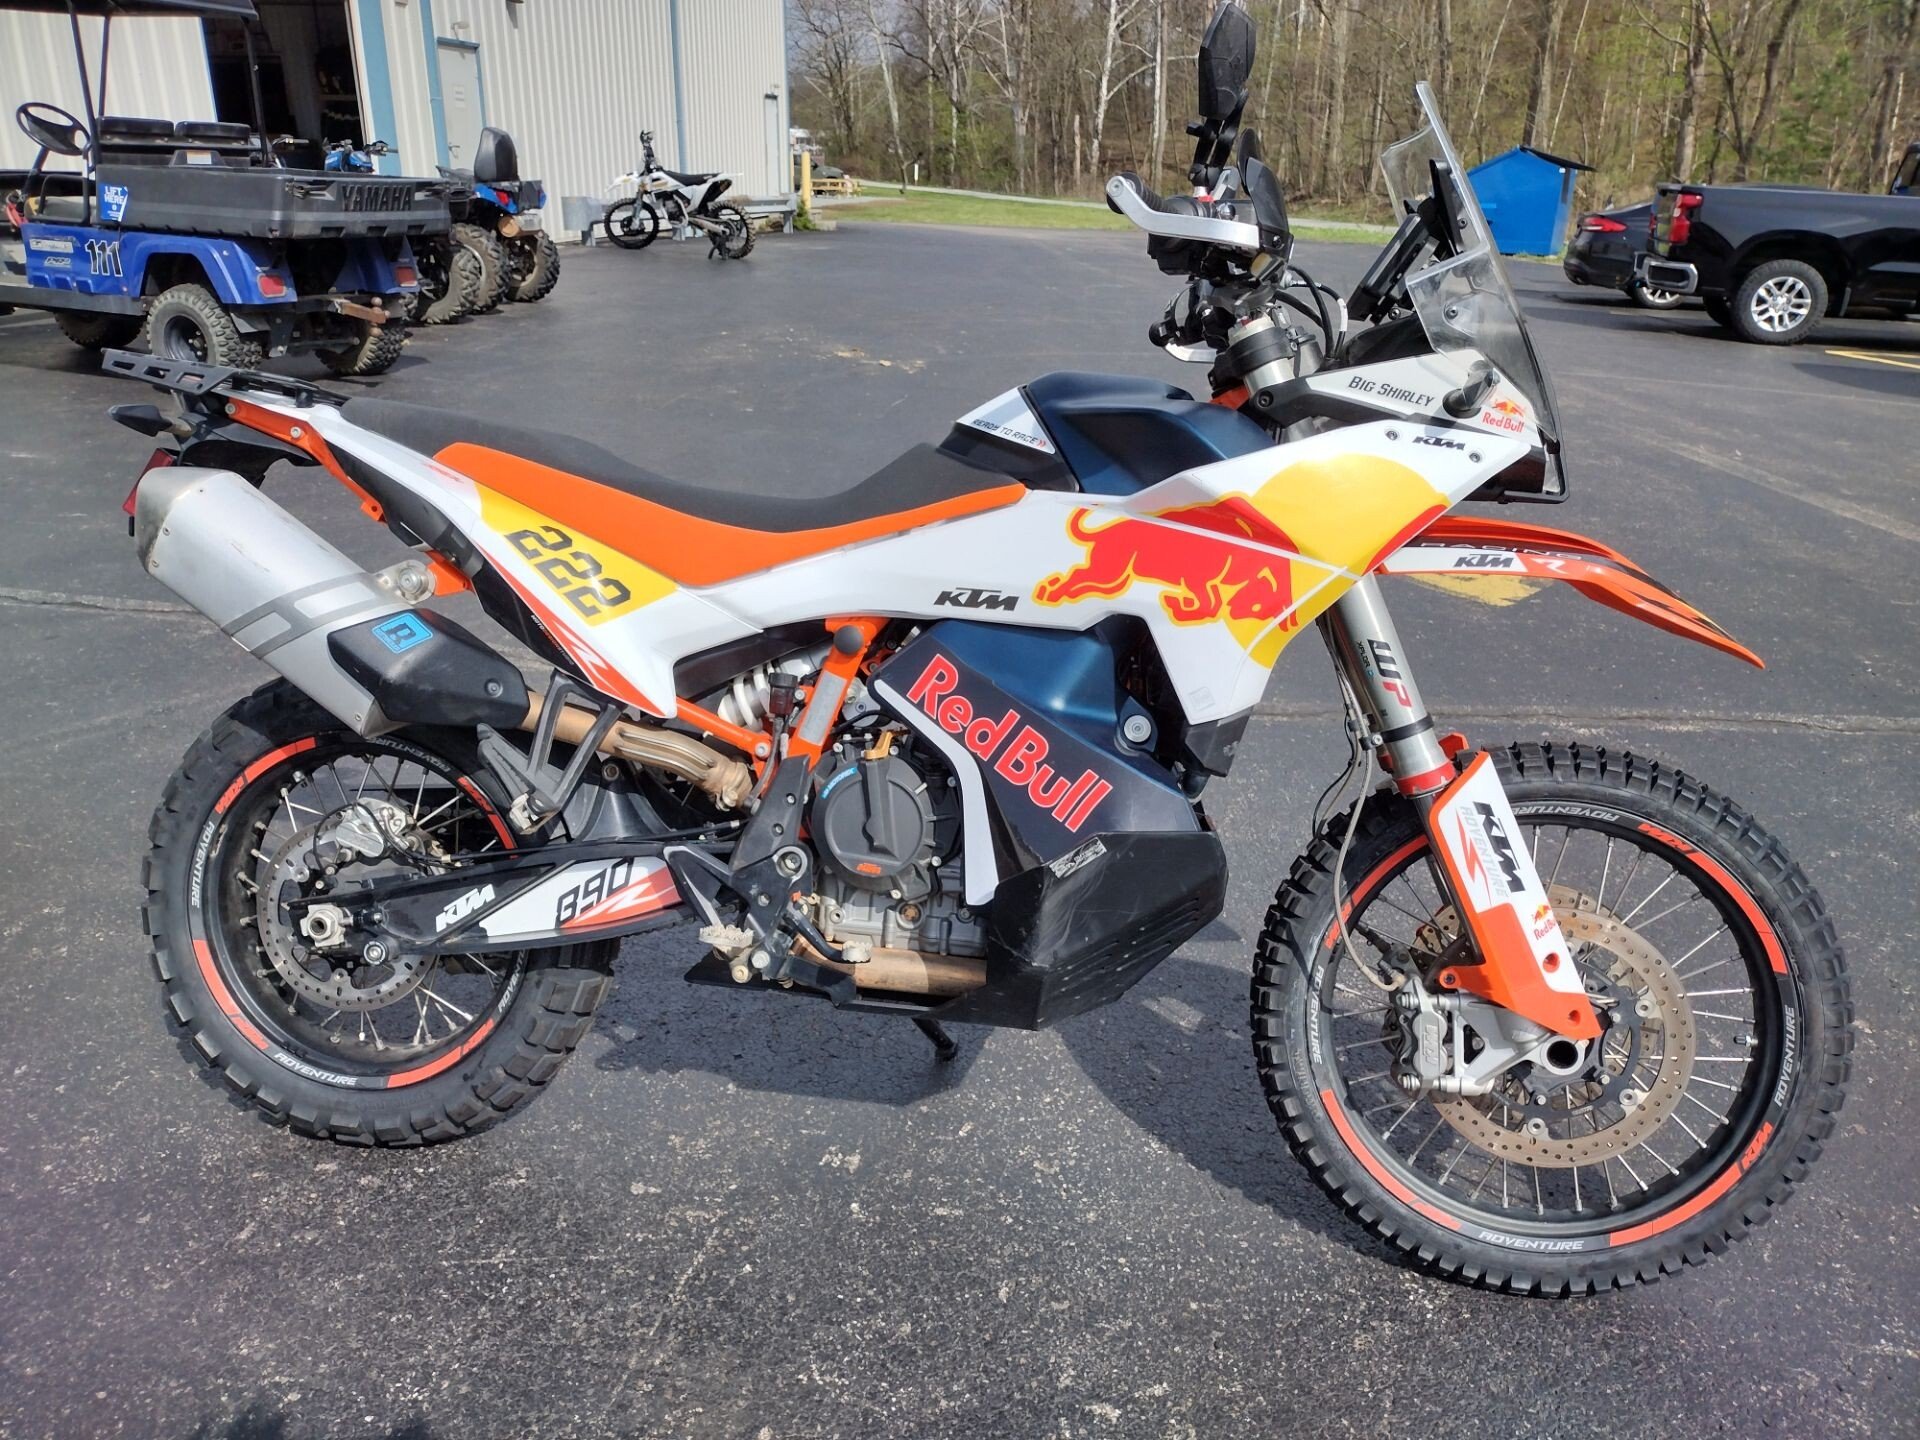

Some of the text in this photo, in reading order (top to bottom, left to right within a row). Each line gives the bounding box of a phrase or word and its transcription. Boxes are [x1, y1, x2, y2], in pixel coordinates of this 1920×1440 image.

[104, 185, 123, 196] LIFT
[342, 184, 412, 212] YAMAHA
[85, 239, 123, 277] 111
[1348, 376, 1435, 407] BIG SHIRLEY
[972, 418, 1038, 445] READY TO RACE
[1482, 411, 1525, 433] Red Bull
[1412, 436, 1466, 451] KTM
[503, 525, 631, 618] 222
[1453, 553, 1514, 568] KTM
[933, 587, 1020, 611] KTM
[906, 653, 1113, 833] Red Bull
[191, 821, 215, 908] ADVENTURE
[1459, 805, 1509, 898] ADVENTURE
[1472, 801, 1526, 893] KTM
[435, 883, 496, 933] KTM
[555, 857, 635, 929] 890
[1310, 965, 1325, 1065] ADVENTURE
[274, 1052, 359, 1086] ADVENTURE
[1774, 1004, 1796, 1107] ADVENTURE
[1741, 1121, 1774, 1170] KTM
[1478, 1231, 1585, 1251] ADVENTURE
